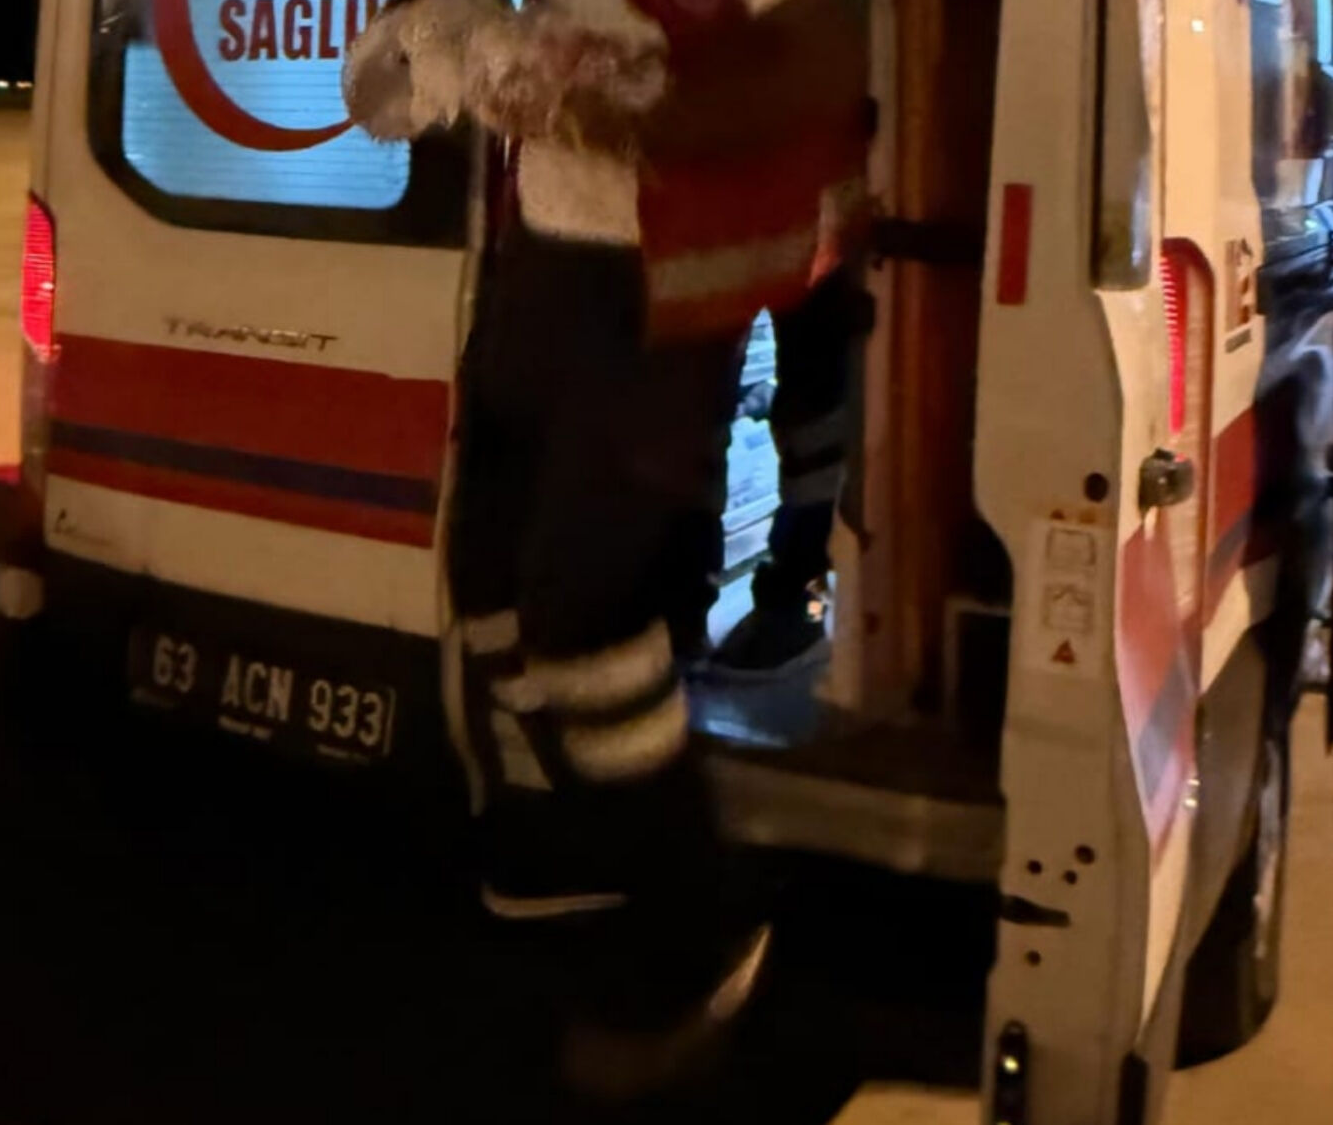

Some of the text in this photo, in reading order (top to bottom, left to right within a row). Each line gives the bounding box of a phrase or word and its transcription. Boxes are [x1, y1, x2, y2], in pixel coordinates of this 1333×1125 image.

[161, 316, 339, 352] TRANSIT
[152, 634, 383, 747] 63 ACN 933
